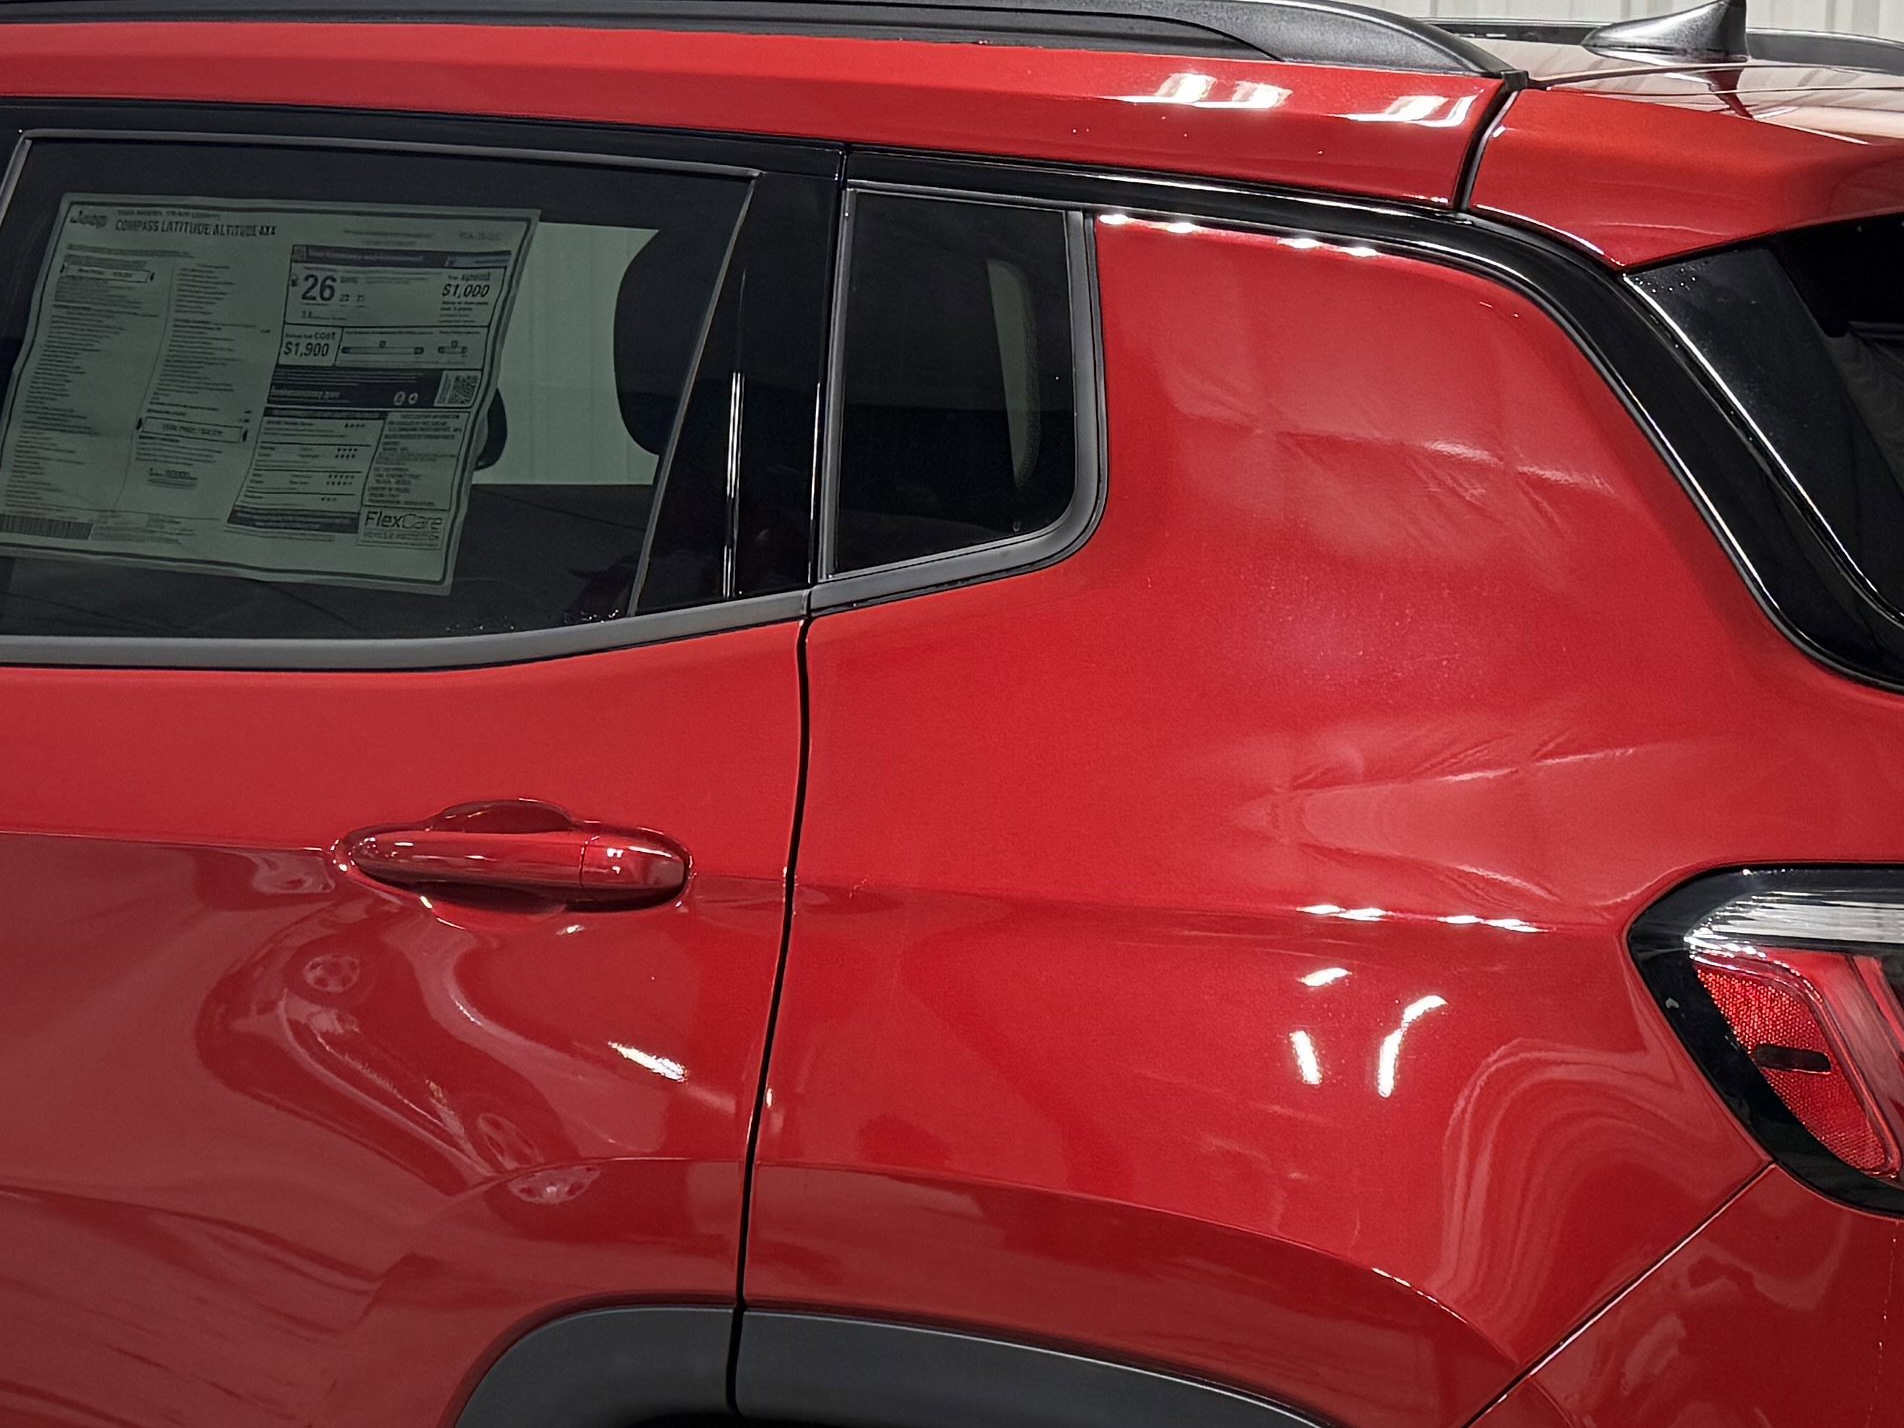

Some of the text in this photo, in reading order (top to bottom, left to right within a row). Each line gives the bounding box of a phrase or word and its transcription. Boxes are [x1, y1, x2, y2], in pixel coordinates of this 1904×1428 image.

[115, 219, 159, 233] COMPASS
[161, 220, 210, 235] LATITUDE
[212, 224, 257, 237] ALTITUDE
[301, 274, 337, 302] 26
[442, 283, 491, 299] $1,000
[283, 342, 330, 358] $1,900
[364, 510, 442, 531] FlexCare
